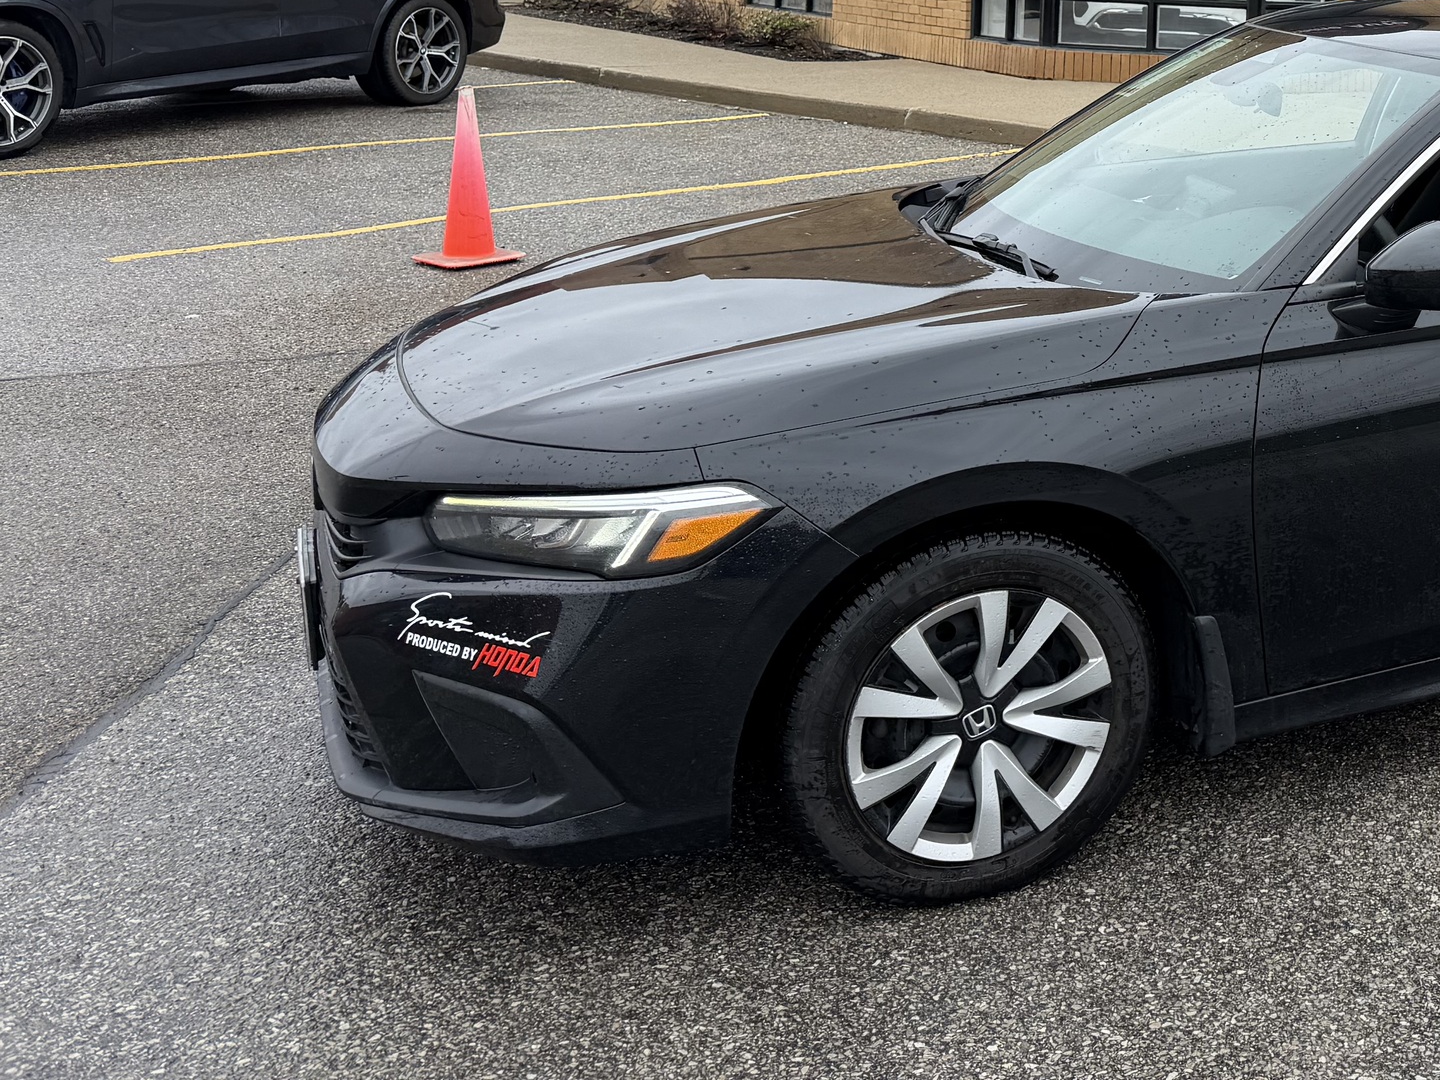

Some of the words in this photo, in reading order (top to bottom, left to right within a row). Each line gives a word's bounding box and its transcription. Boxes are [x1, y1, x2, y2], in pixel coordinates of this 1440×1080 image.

[405, 631, 460, 657] PRODUCED
[461, 646, 478, 662] BY
[471, 642, 542, 678] HONDA
